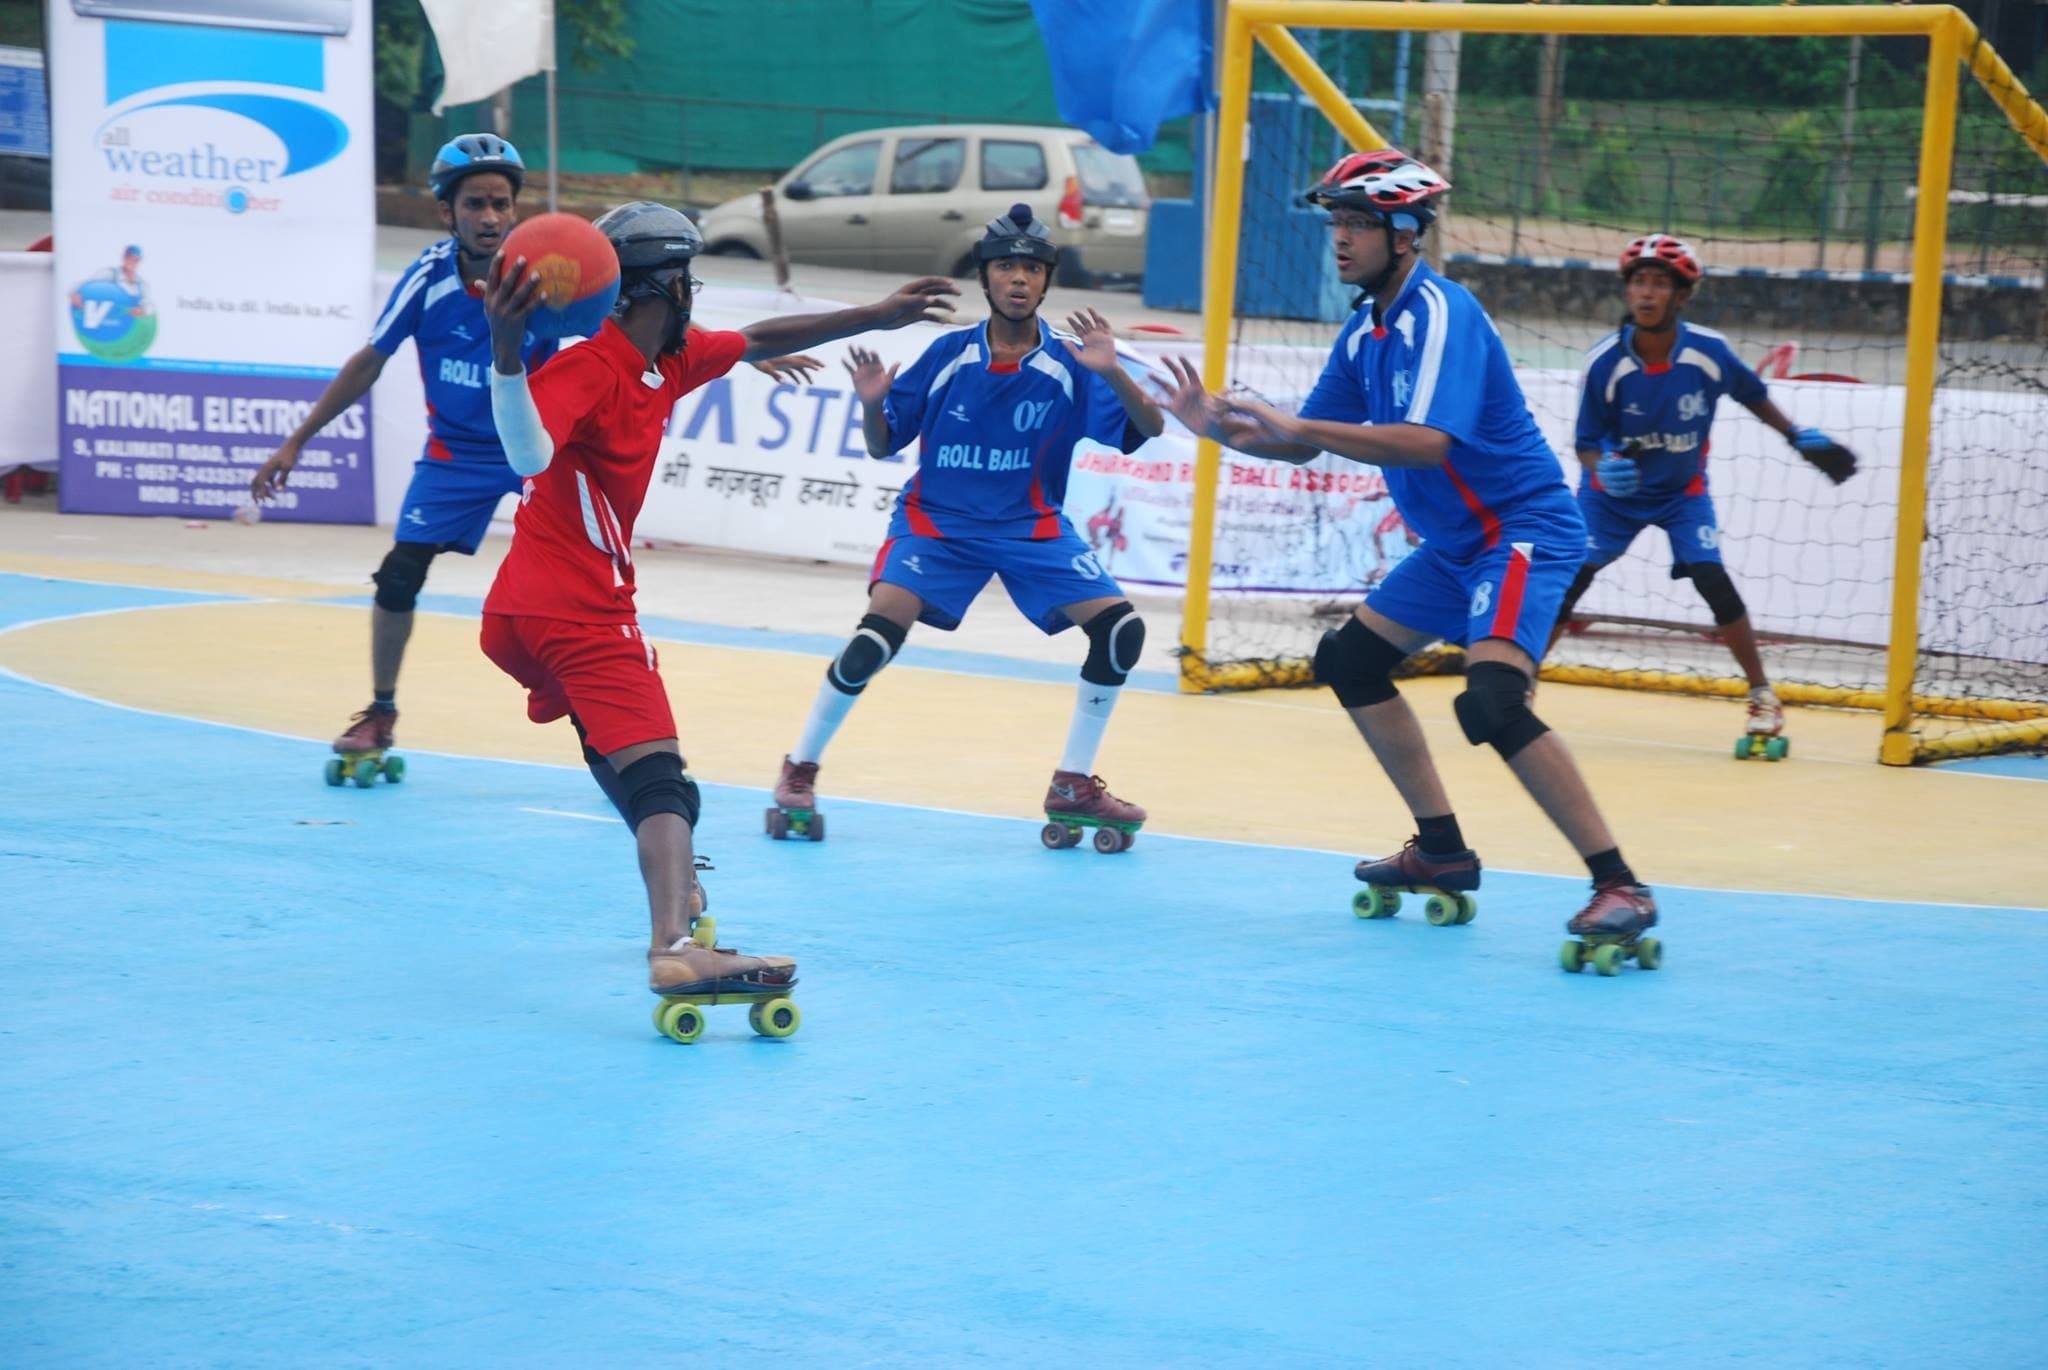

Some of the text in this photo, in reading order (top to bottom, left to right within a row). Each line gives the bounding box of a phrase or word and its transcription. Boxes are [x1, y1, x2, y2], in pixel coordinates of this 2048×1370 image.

[102, 127, 130, 146] all
[101, 143, 276, 183] weather
[110, 184, 140, 202] air
[440, 358, 482, 388] ROLL
[66, 388, 200, 433] NATIONAL
[757, 383, 921, 466] STE
[1014, 399, 1053, 432] 07
[937, 444, 1031, 471] ROLL BALL
[798, 471, 861, 508] हमारे
[1231, 463, 1279, 488] BALL
